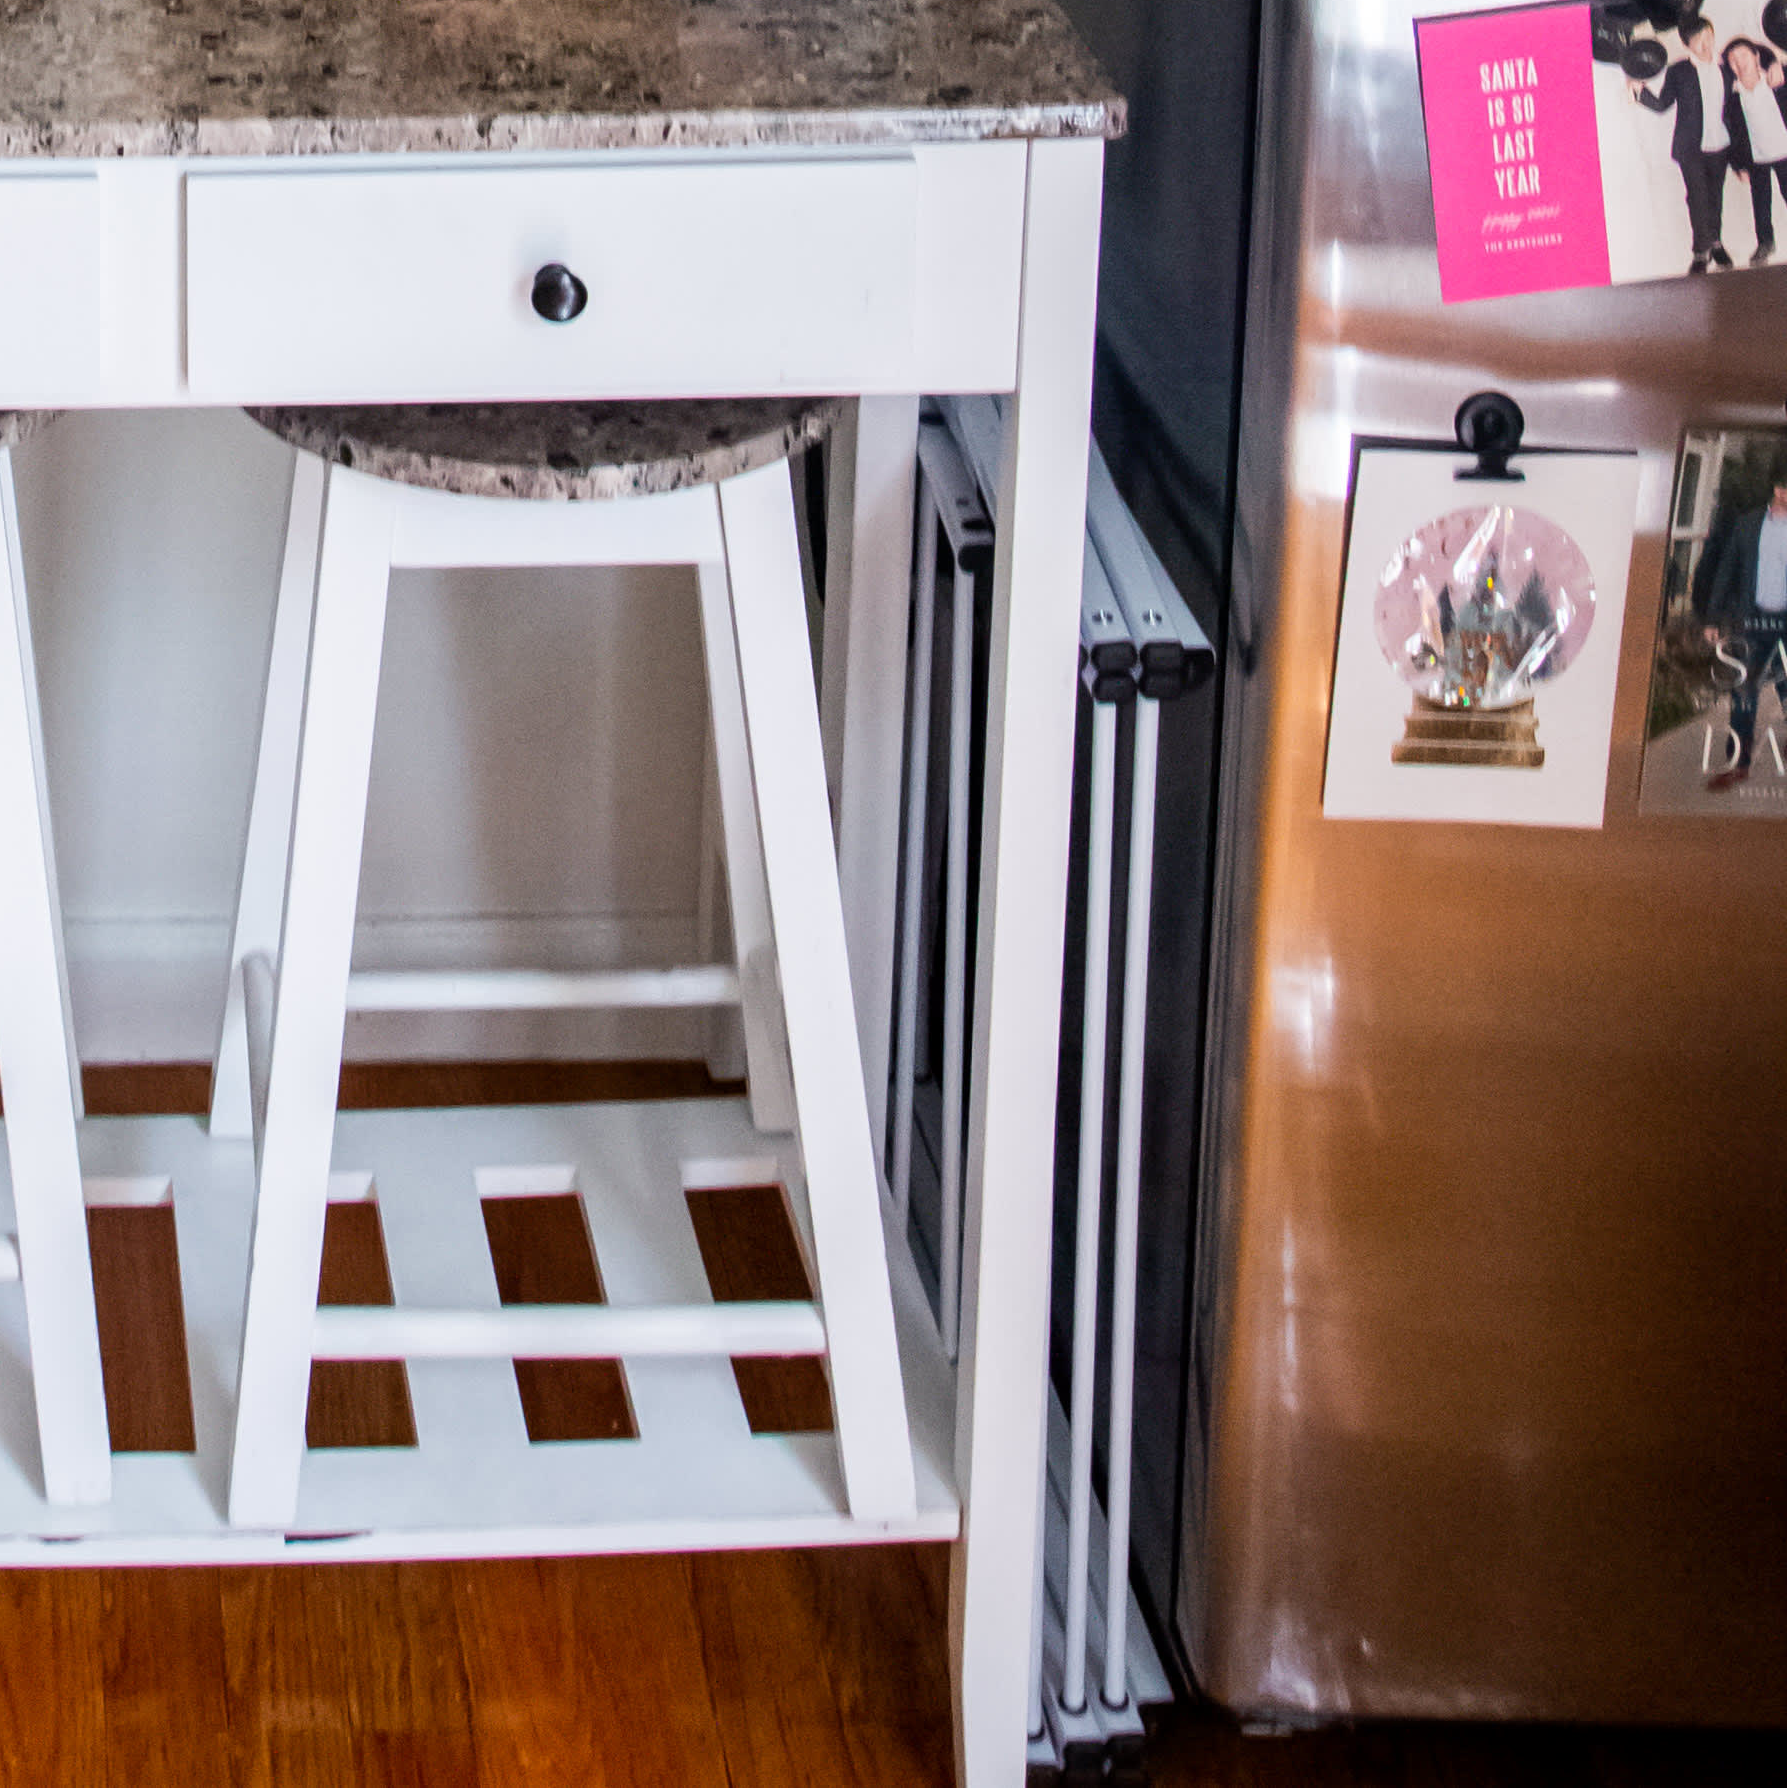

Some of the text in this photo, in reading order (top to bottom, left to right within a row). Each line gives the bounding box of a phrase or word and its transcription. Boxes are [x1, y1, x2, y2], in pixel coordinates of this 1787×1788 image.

[1479, 56, 1539, 94] SANTA
[1487, 93, 1536, 130] IS SO
[1492, 127, 1535, 165] LAST
[1493, 163, 1541, 201] YEAR
